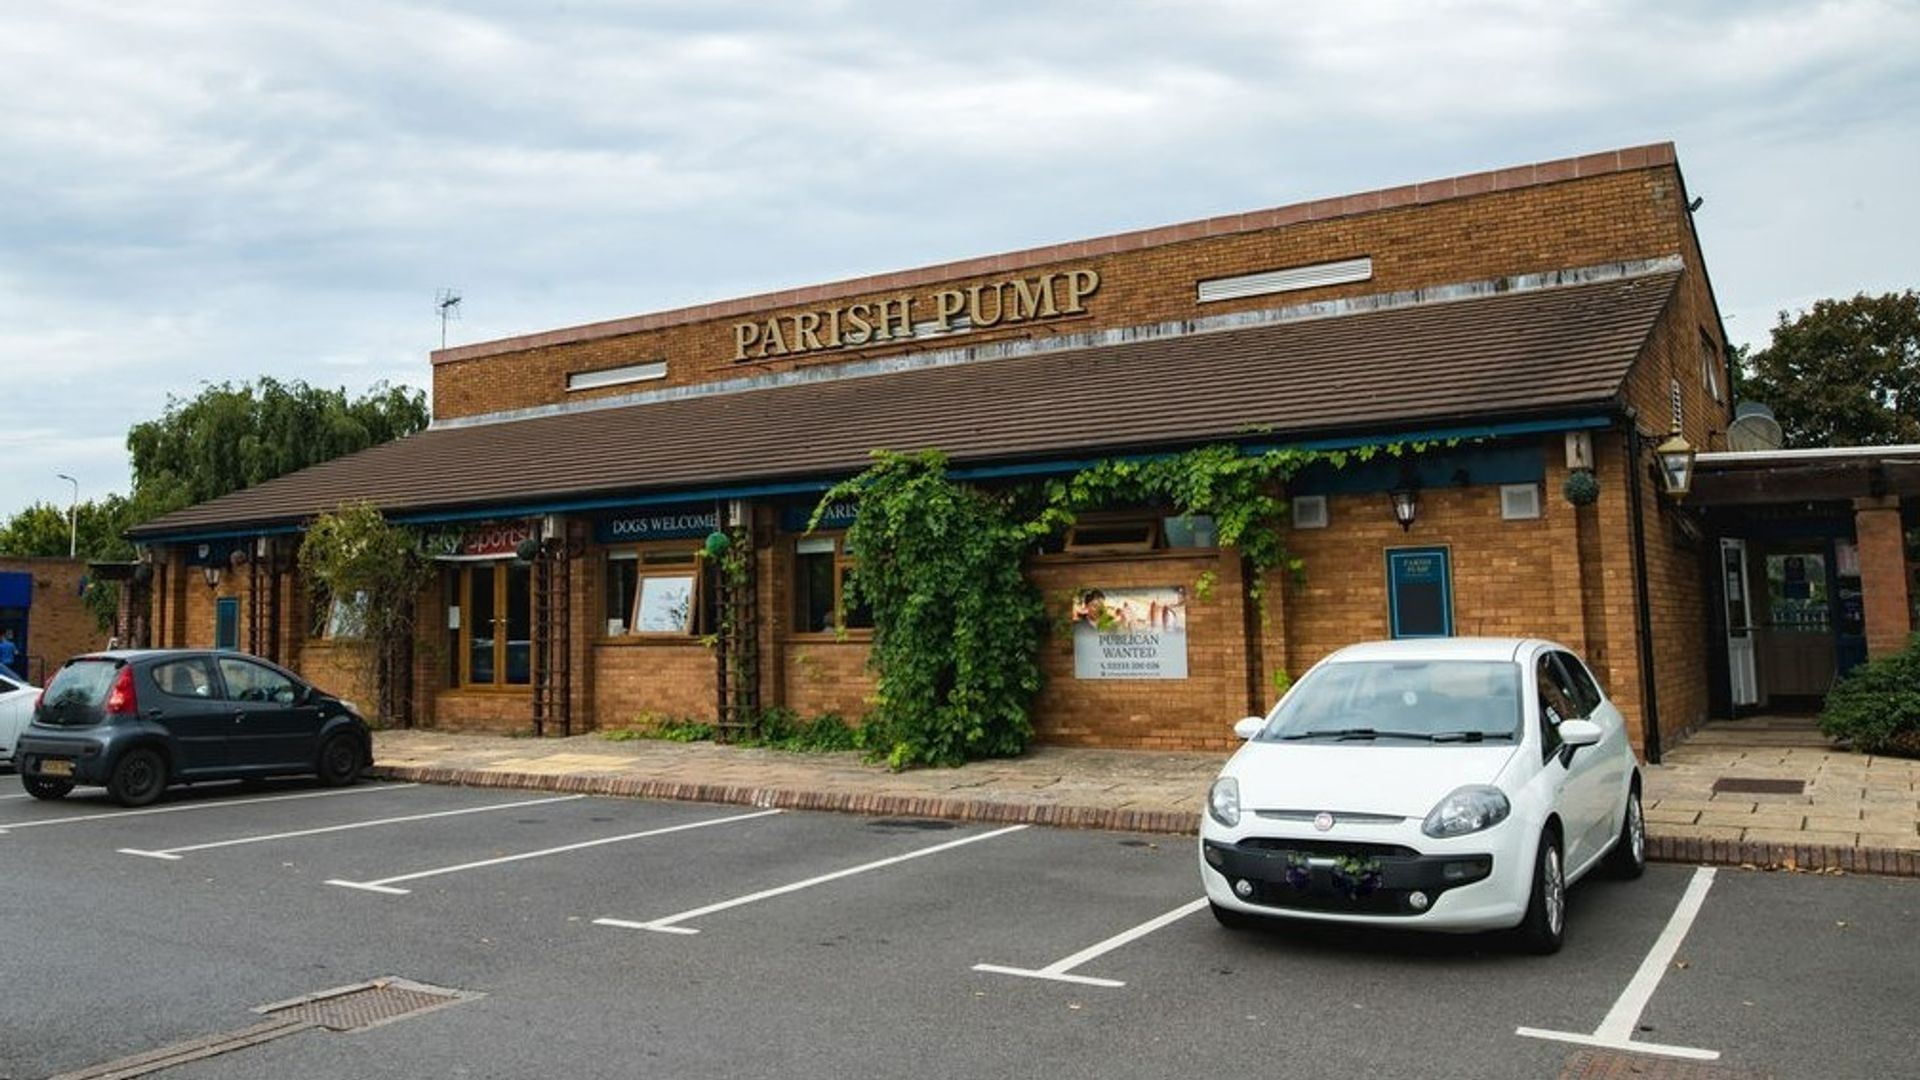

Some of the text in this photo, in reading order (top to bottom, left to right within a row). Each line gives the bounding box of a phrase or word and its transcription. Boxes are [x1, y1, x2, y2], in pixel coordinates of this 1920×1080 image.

[733, 269, 1101, 362] PARISH PUMP
[612, 513, 719, 535] DOGS WELCOME
[1099, 634, 1160, 646] PUBLICAN
[1102, 647, 1157, 659] WANTED
